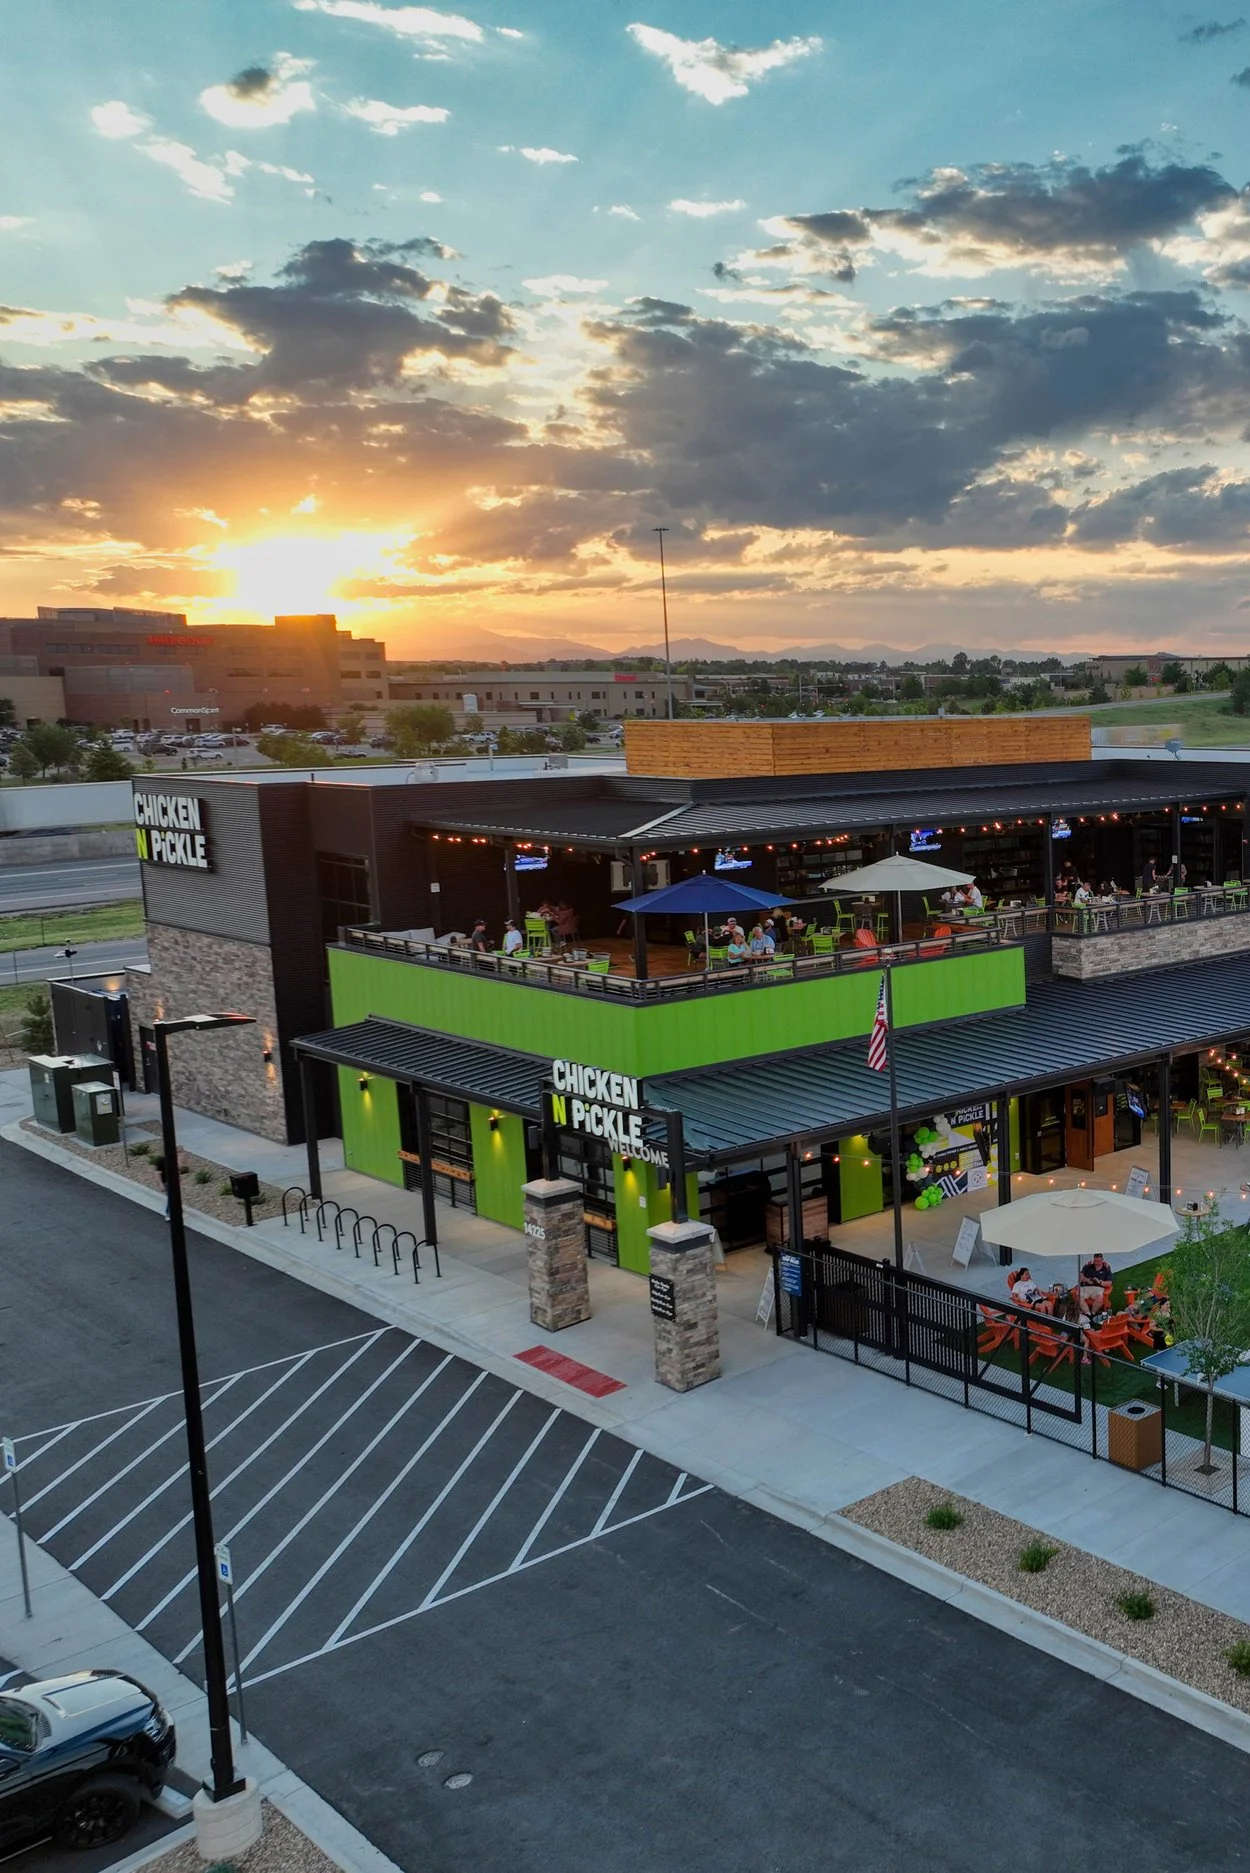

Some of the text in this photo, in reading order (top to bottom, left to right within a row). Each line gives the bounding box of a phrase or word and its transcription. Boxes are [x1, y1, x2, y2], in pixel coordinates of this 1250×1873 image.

[134, 793, 201, 831] CHICKEN
[136, 828, 149, 860] N
[552, 1059, 639, 1110] CHICKEN
[552, 1093, 567, 1126] N
[607, 1138, 670, 1168] WELCOME
